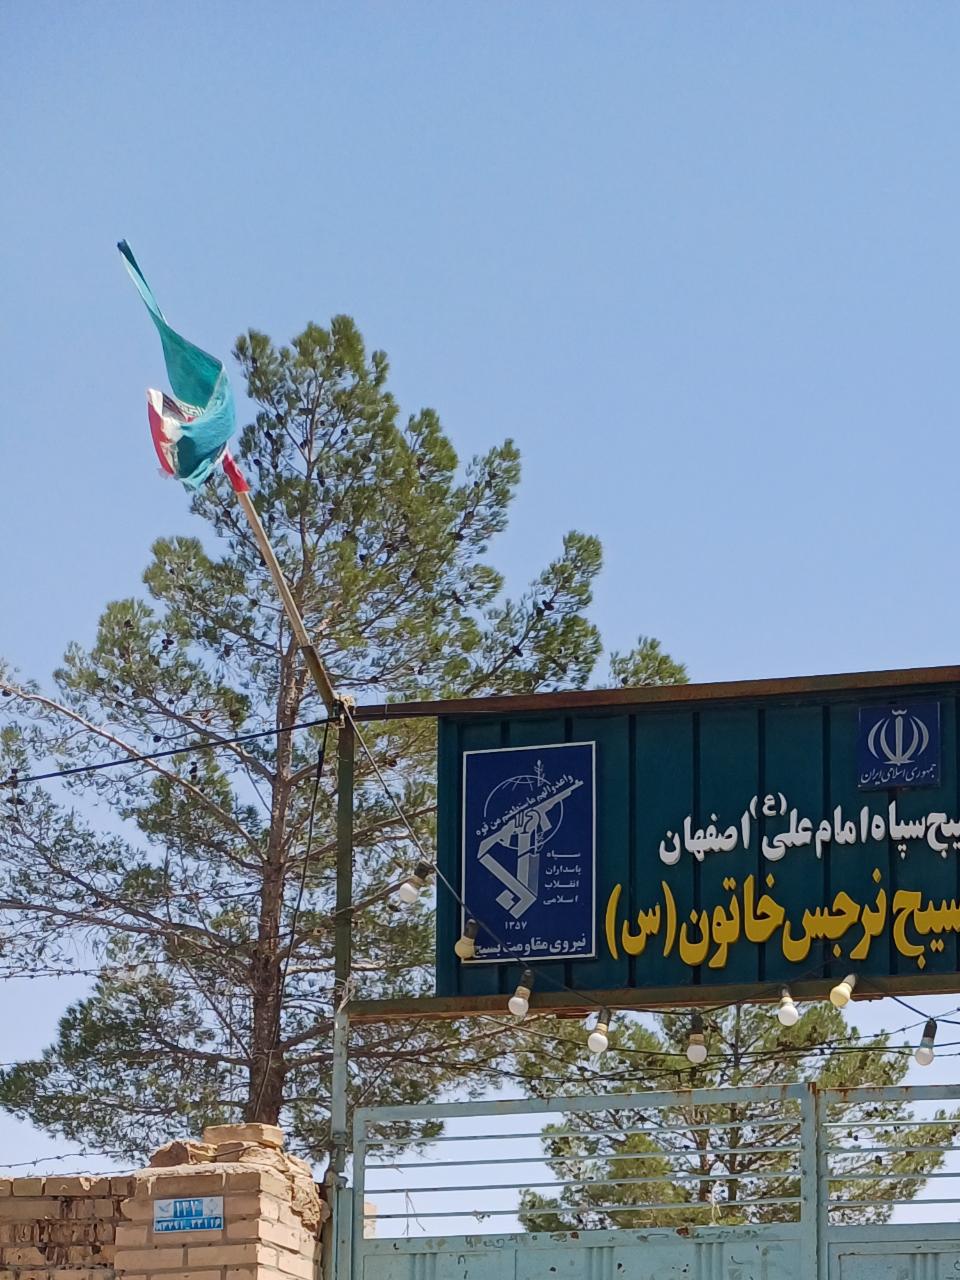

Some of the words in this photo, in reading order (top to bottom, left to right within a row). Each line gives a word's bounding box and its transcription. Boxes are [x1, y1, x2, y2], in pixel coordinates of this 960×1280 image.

[860, 767, 882, 786] ایران
[881, 767, 905, 783] اسلامی
[905, 763, 937, 782] جمهوری
[749, 791, 788, 820] (ع)
[658, 809, 750, 866] اصفهان
[762, 807, 813, 862] علی
[815, 804, 870, 860] امام
[871, 800, 926, 860] سپاه
[545, 850, 581, 861] سپاه
[545, 864, 583, 876] پاسداران
[543, 880, 580, 891] انقلاب
[542, 895, 580, 906] اسلامی
[605, 880, 678, 961] (س)
[679, 873, 785, 969] خاتون
[782, 867, 888, 963] نرجس
[504, 921, 528, 931] ۱۳۵۷
[503, 936, 549, 956] مقاومت
[549, 932, 587, 954] نیروی
